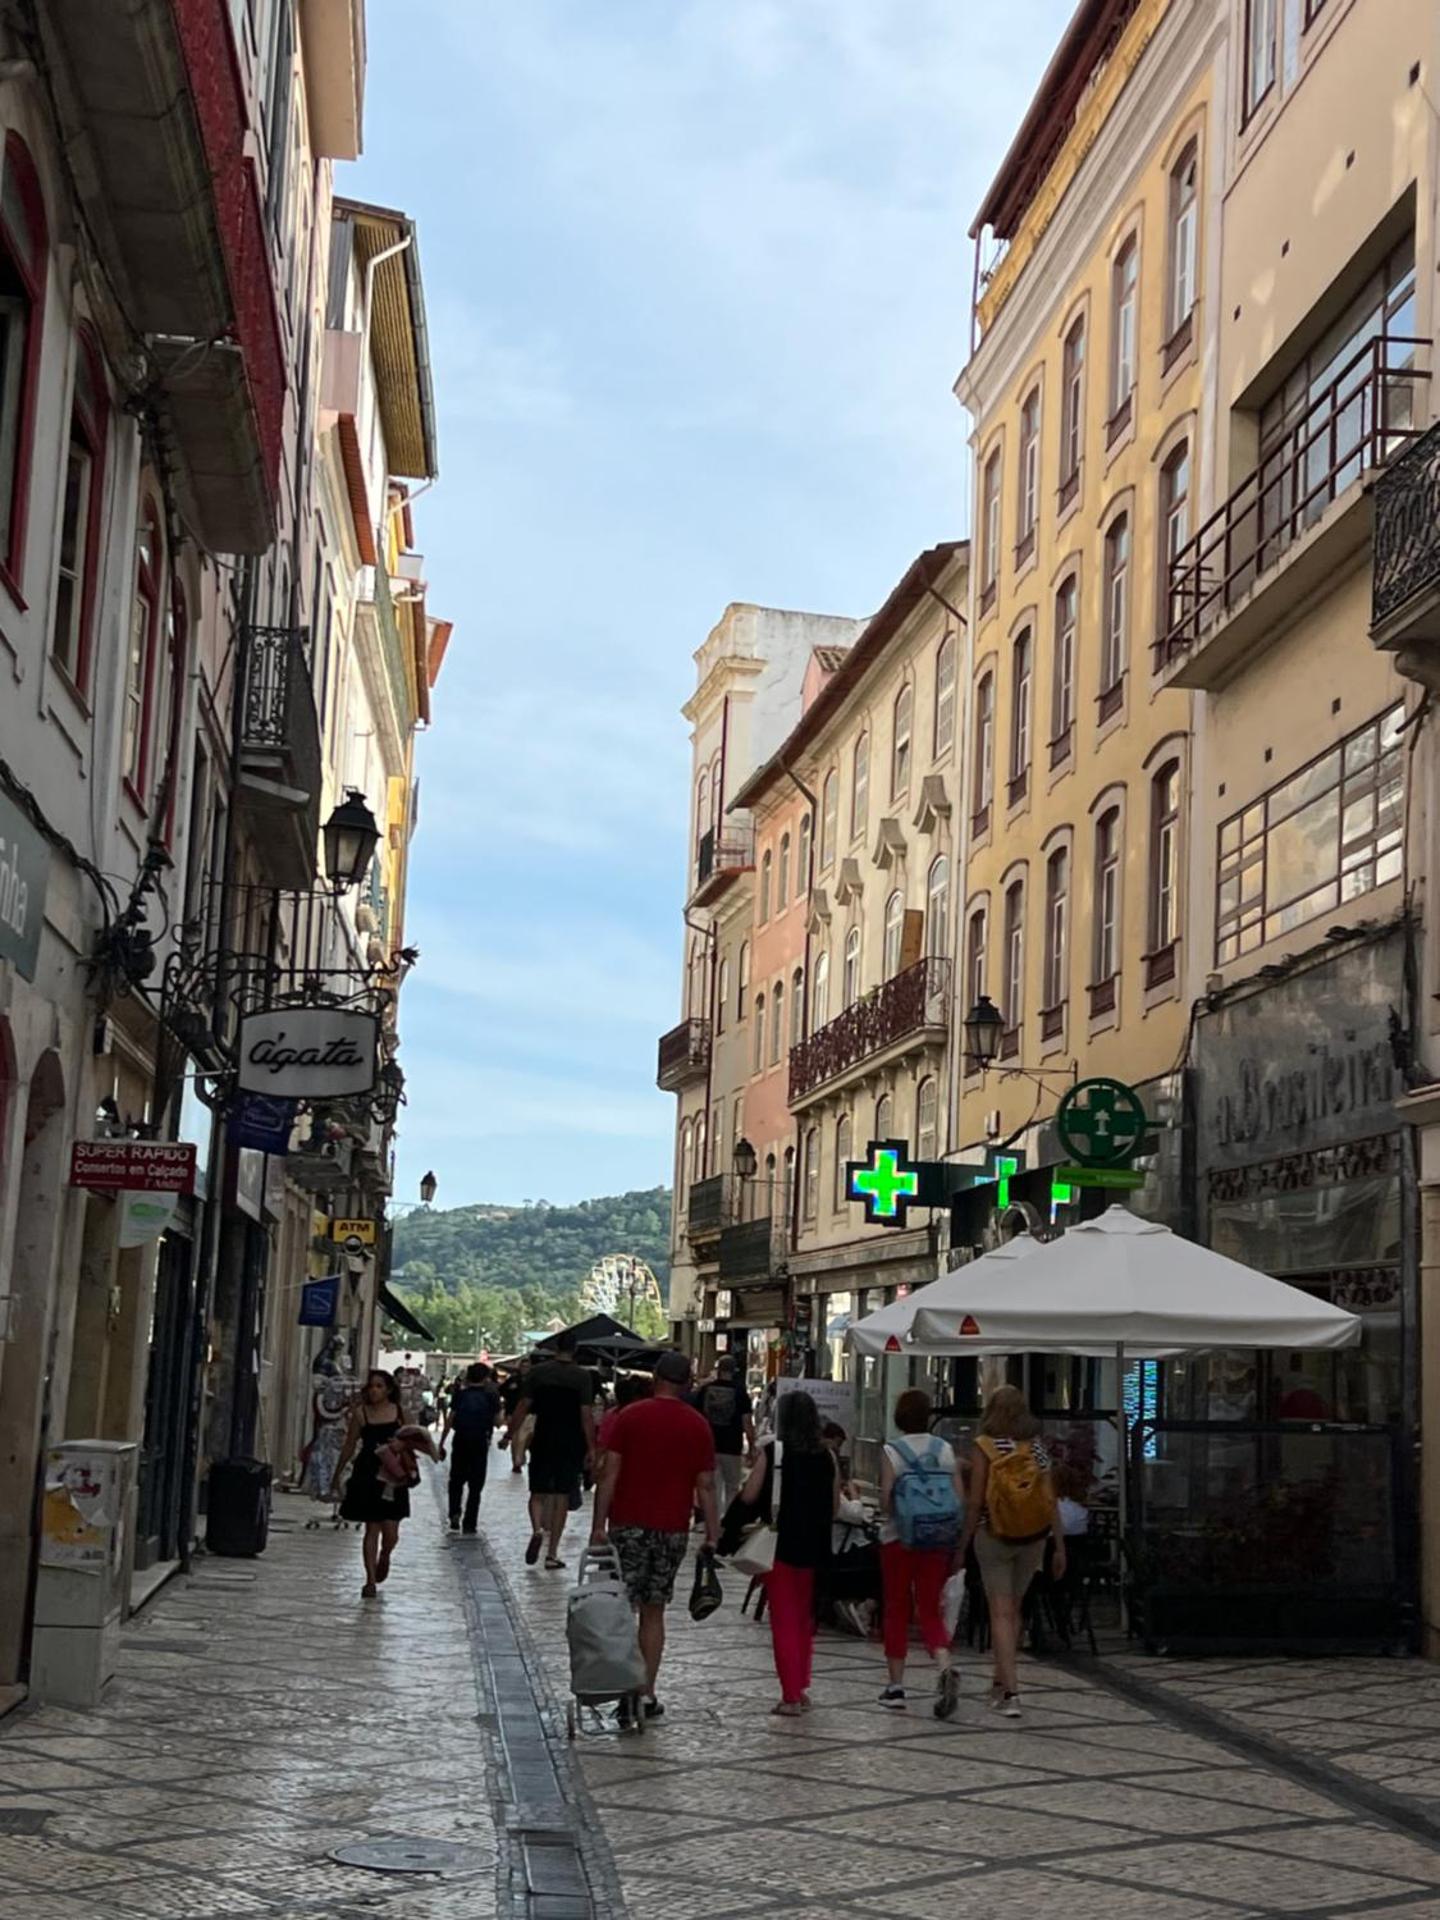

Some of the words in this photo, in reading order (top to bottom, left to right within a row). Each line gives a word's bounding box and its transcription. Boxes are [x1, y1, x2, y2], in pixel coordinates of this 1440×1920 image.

[76, 1144, 126, 1159] SUPER
[129, 1165, 145, 1175] em
[339, 1222, 370, 1232] ATM
